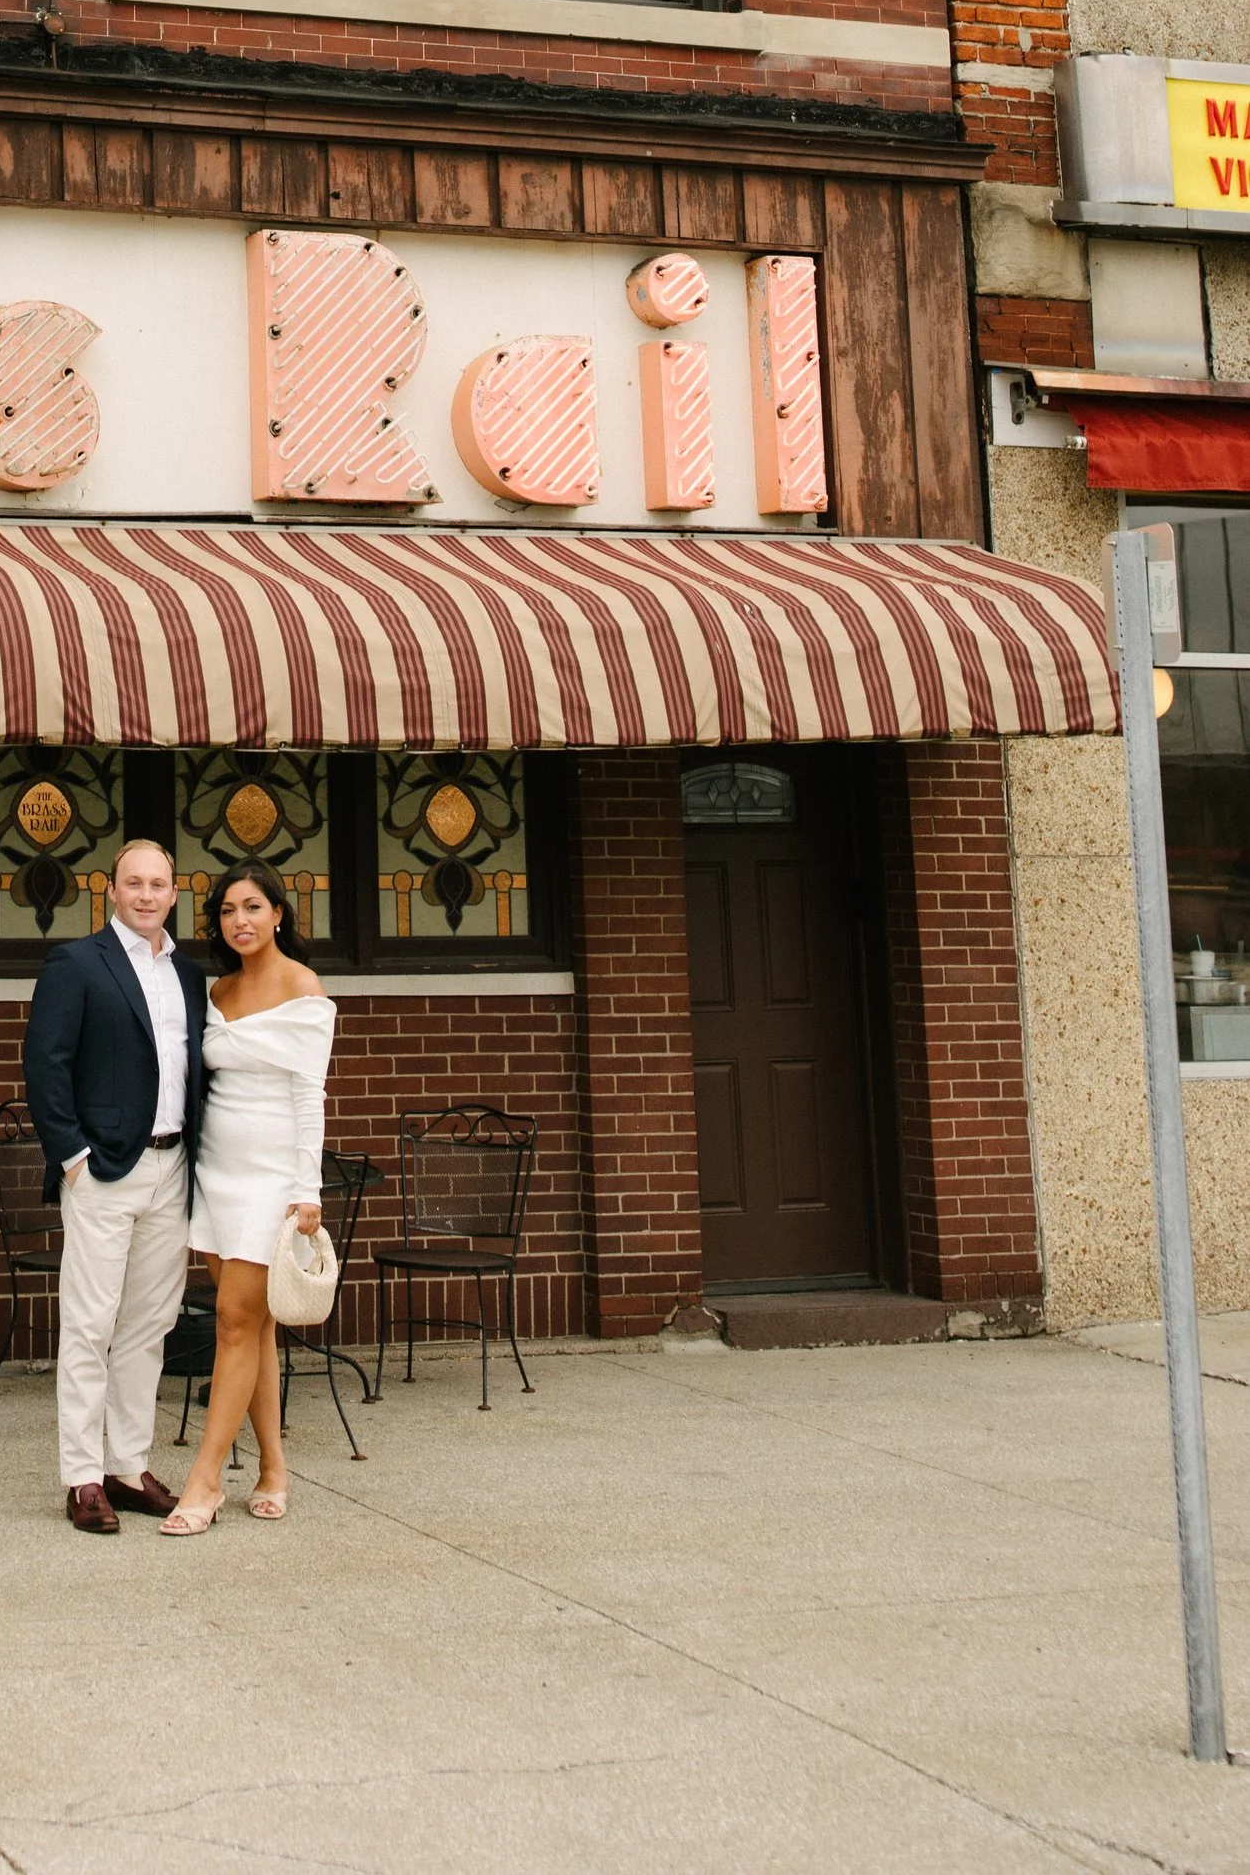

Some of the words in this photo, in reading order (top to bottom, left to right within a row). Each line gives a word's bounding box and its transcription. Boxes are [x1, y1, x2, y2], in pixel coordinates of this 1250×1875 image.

[1205, 97, 1250, 139] M
[246, 227, 829, 516] Rail
[36, 791, 53, 802] THE
[21, 803, 68, 817] BRASS
[29, 818, 60, 832] RAIL
